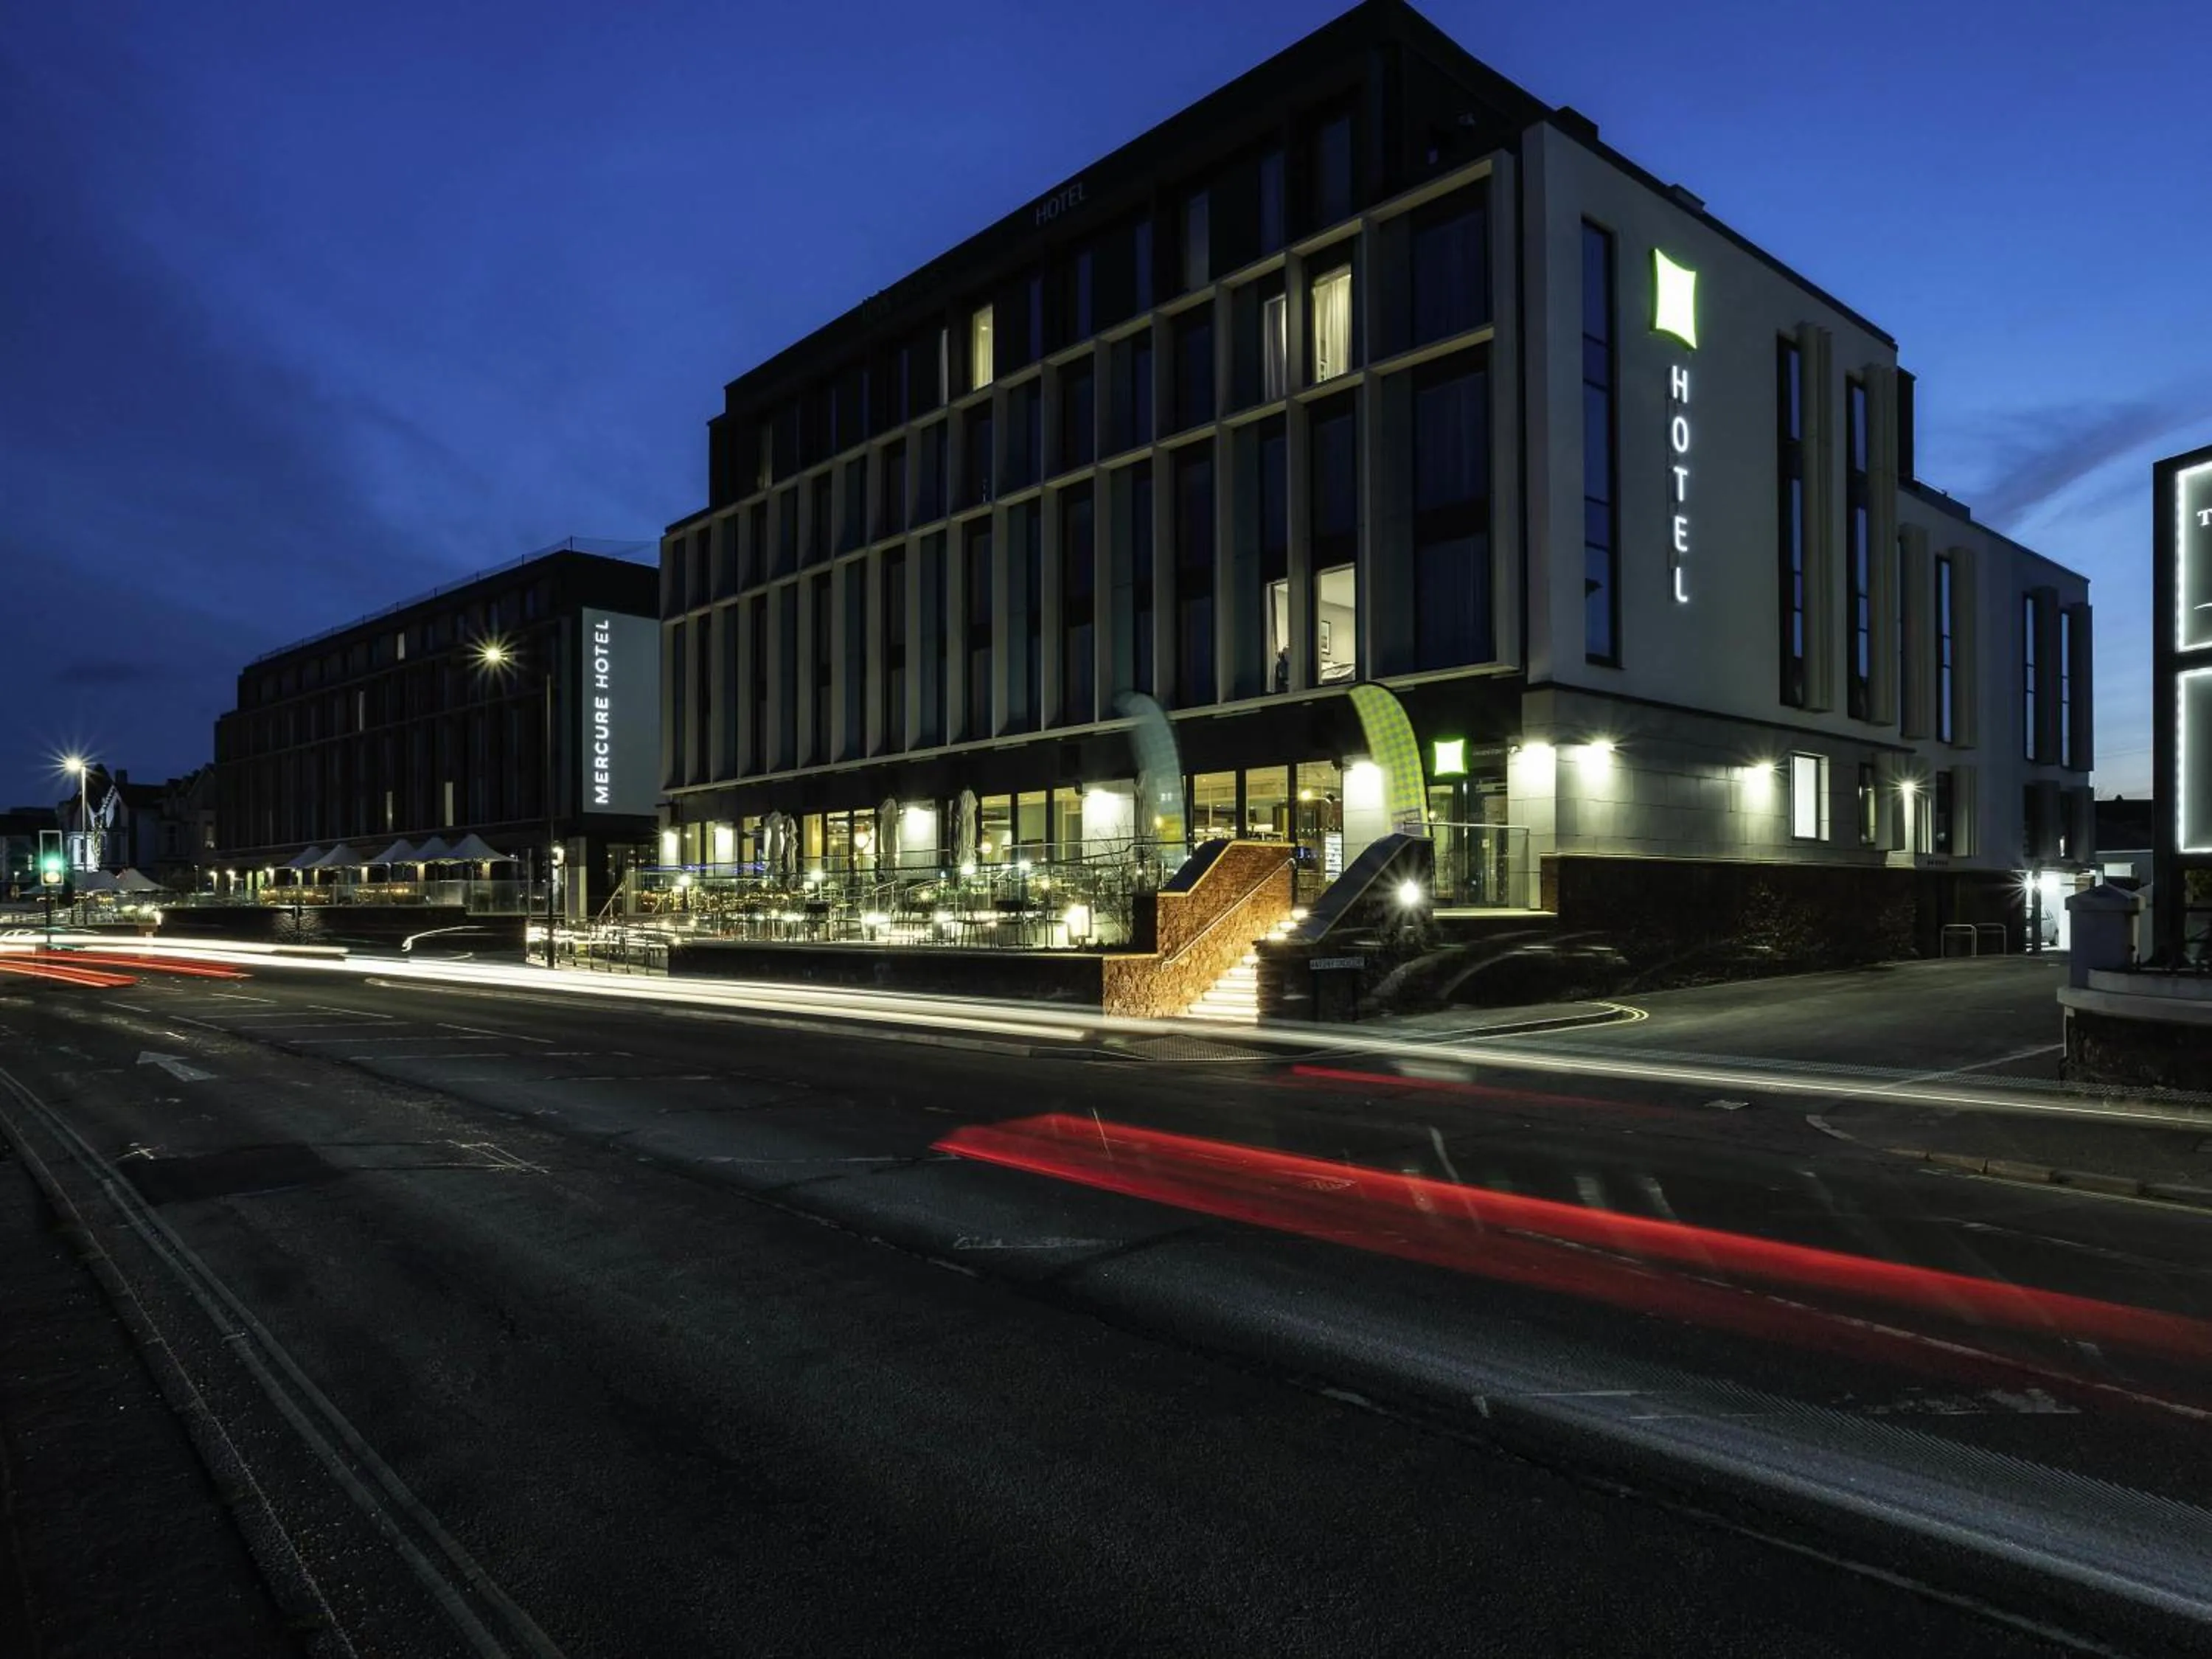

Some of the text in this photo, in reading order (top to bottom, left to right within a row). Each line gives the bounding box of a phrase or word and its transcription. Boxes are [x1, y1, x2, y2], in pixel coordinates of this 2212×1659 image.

[1034, 181, 1088, 226] HOTEL
[1669, 364, 1689, 603] HOTEL
[594, 619, 610, 805] MERCURE HOTEL
